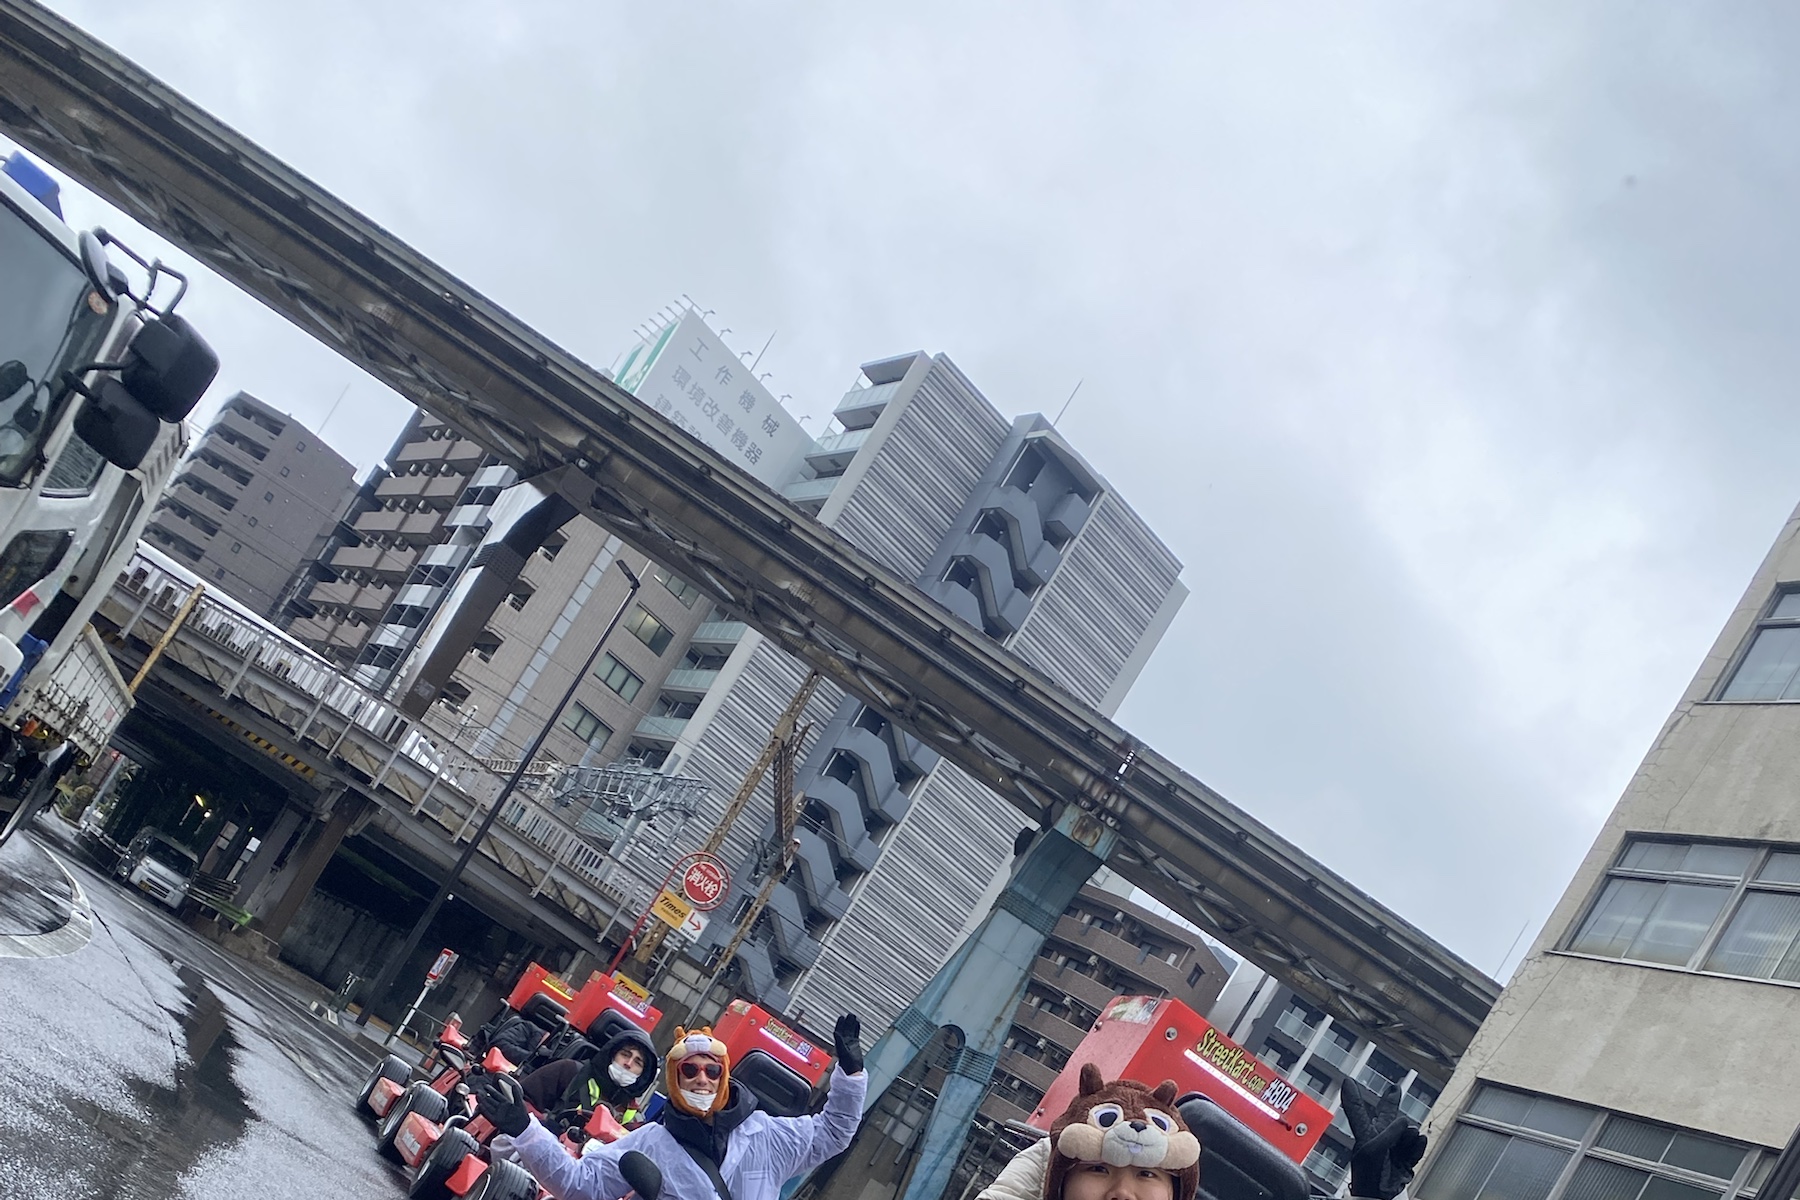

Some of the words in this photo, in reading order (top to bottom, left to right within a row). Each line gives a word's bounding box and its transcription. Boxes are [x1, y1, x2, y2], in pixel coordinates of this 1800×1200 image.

[670, 364, 764, 466] 環境改善機器
[688, 336, 780, 438] 工作機械
[660, 895, 687, 919] Times
[686, 866, 720, 899] 消火栓
[1196, 1027, 1267, 1096] StreetKart.com
[1261, 1077, 1299, 1115] #804
